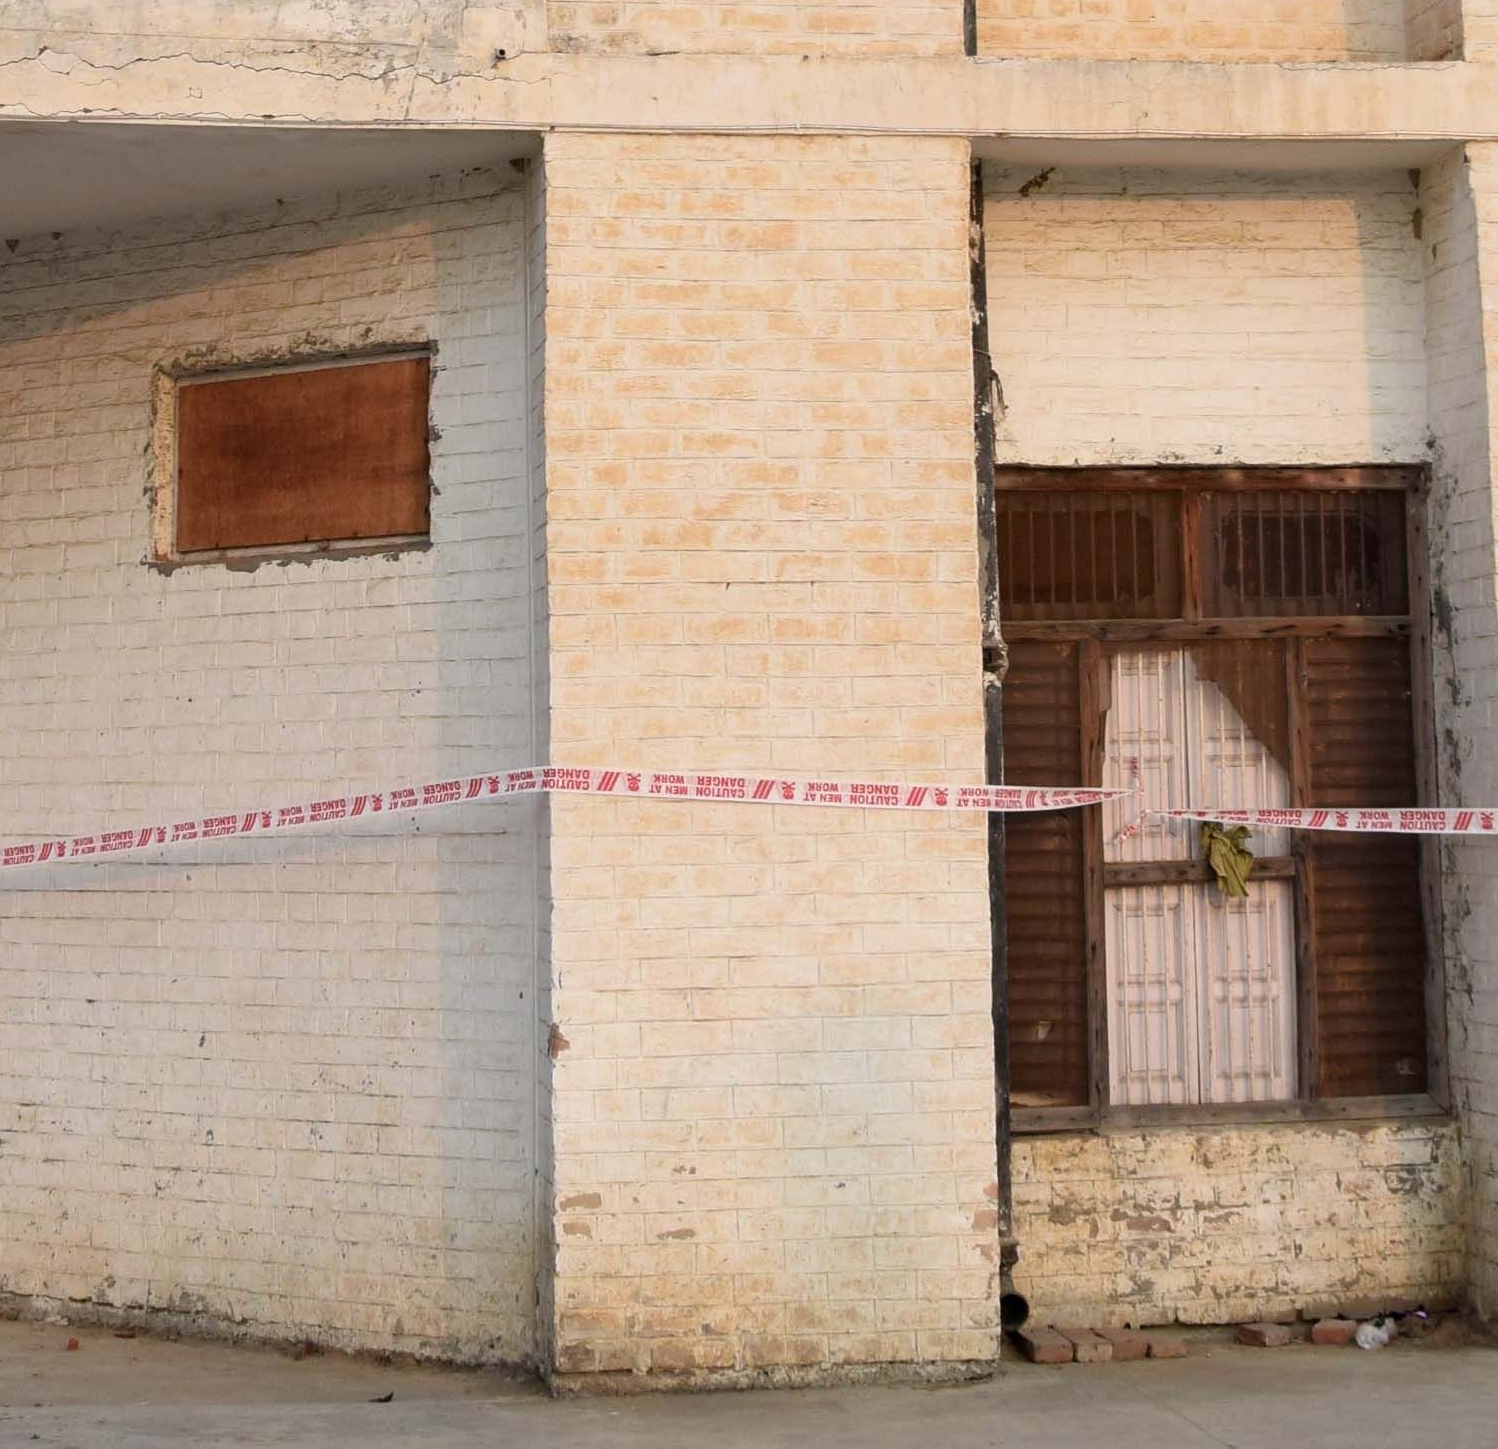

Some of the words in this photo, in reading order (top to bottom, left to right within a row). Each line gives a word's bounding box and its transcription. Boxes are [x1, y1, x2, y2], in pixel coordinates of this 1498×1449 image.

[508, 769, 533, 781] WORK
[543, 768, 589, 779] DANGER
[653, 773, 684, 785] WORK
[519, 779, 536, 791] MEN
[542, 779, 589, 790] CAUTION
[697, 775, 745, 787] DANGER
[808, 781, 839, 791] WORK
[423, 780, 460, 795] DANGER
[505, 781, 517, 793] AT
[649, 783, 662, 794] AT
[665, 784, 688, 795] MEN
[696, 785, 745, 798] CAUTION
[851, 783, 898, 795] DANGER
[960, 787, 989, 797] WORK
[995, 788, 1021, 797] DANGER
[391, 787, 415, 800] WORK
[423, 790, 460, 805] CAUTION
[803, 791, 816, 802] AT
[819, 792, 842, 802] MEN
[849, 793, 898, 805] CAUTION
[311, 799, 345, 813] DANGER
[389, 799, 400, 809] AT
[403, 796, 418, 807] MEN
[957, 797, 969, 808] AT
[995, 798, 1021, 808] CAUTION
[279, 805, 302, 817] WORK
[310, 809, 345, 822] CAUTION
[1360, 810, 1389, 821] WORK
[1400, 810, 1445, 821] DANGER
[203, 814, 237, 828] DANGER
[277, 817, 287, 827] AT
[291, 815, 305, 825] MEN
[1256, 815, 1301, 826] CAUTION
[1357, 819, 1368, 829] AT
[1371, 819, 1392, 830] MEN
[1400, 819, 1445, 830] CAUTION
[174, 820, 195, 832] WORK
[203, 824, 236, 837] CAUTION
[101, 830, 133, 843] DANGER
[171, 832, 180, 843] AT
[181, 830, 197, 841] MEN
[73, 836, 93, 847] WORK
[100, 839, 133, 852] CAUTION
[4, 845, 34, 856] DANGER
[70, 847, 79, 856] AT
[82, 845, 95, 855] MEN
[4, 853, 34, 865] CAUTION
